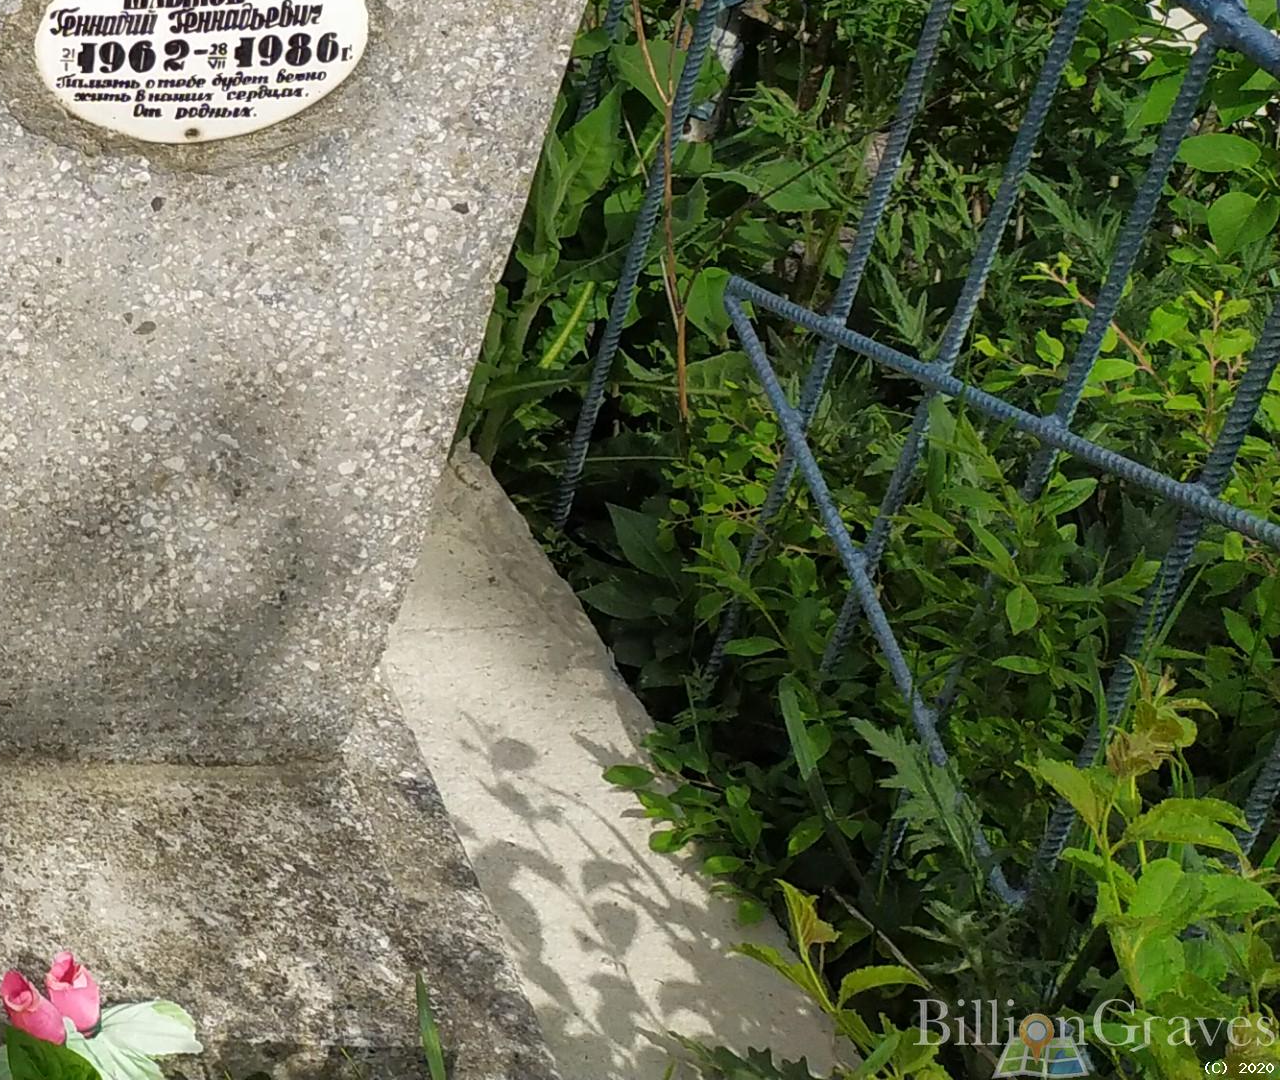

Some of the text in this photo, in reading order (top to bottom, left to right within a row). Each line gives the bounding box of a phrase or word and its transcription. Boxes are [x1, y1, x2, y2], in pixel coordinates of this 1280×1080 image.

[49, 0, 324, 37] Геннадий Геннадьевич
[56, 75, 140, 90] Память
[211, 71, 269, 91] будет
[133, 104, 162, 118] От
